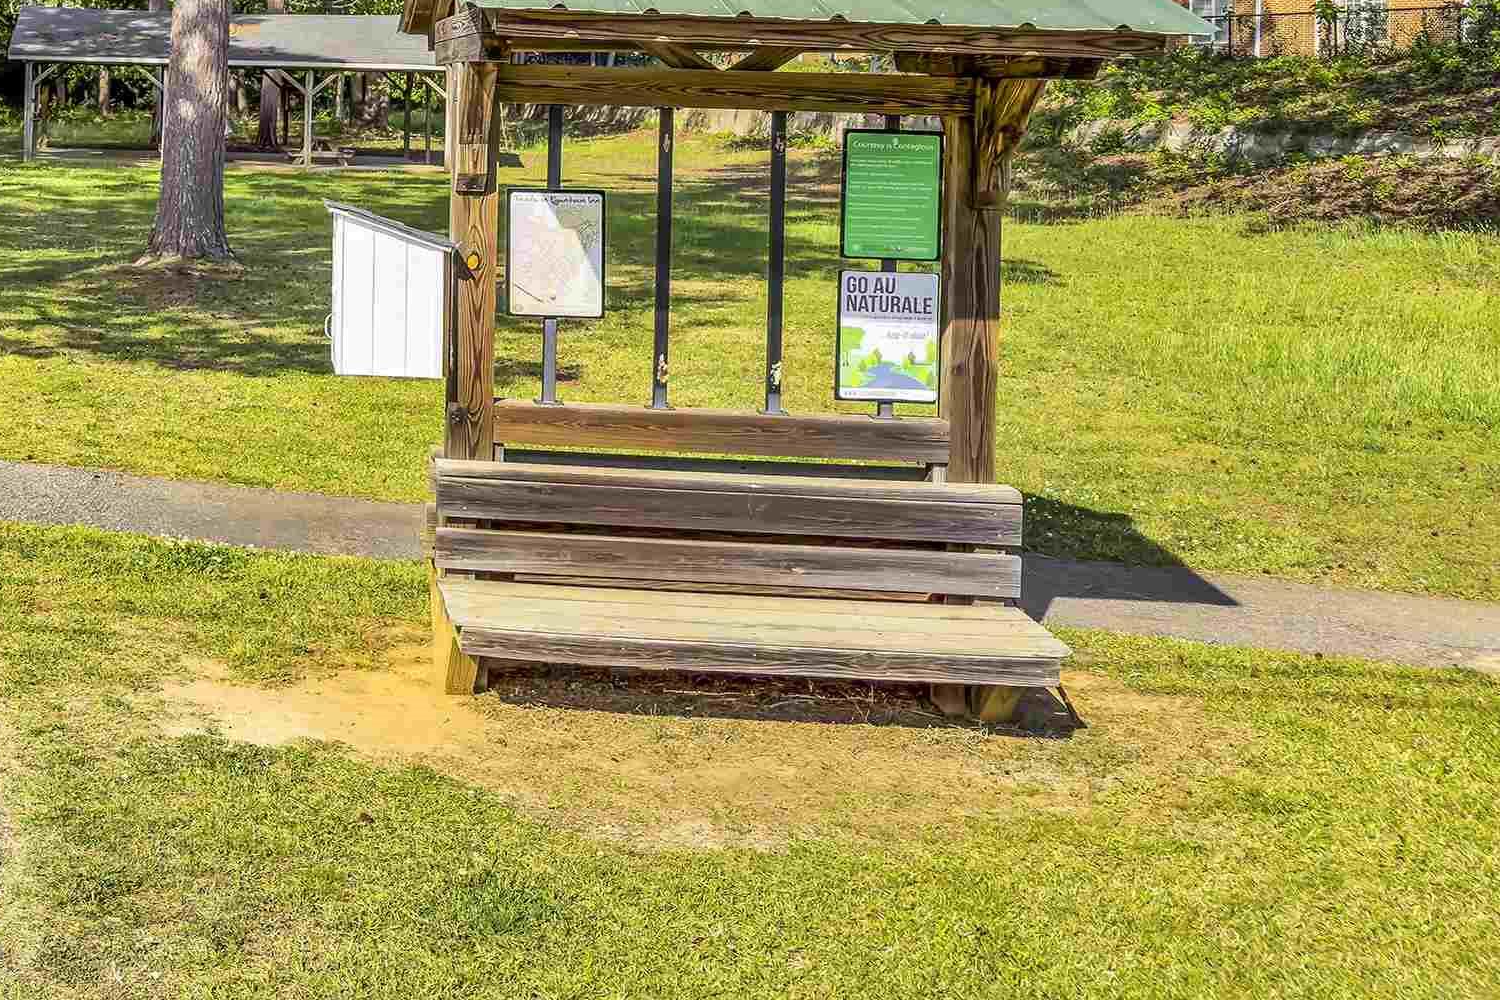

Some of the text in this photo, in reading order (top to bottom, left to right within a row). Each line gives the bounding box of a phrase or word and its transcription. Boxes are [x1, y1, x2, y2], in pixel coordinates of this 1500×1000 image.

[846, 276, 896, 295] GO AU
[846, 294, 933, 315] NATURALE
